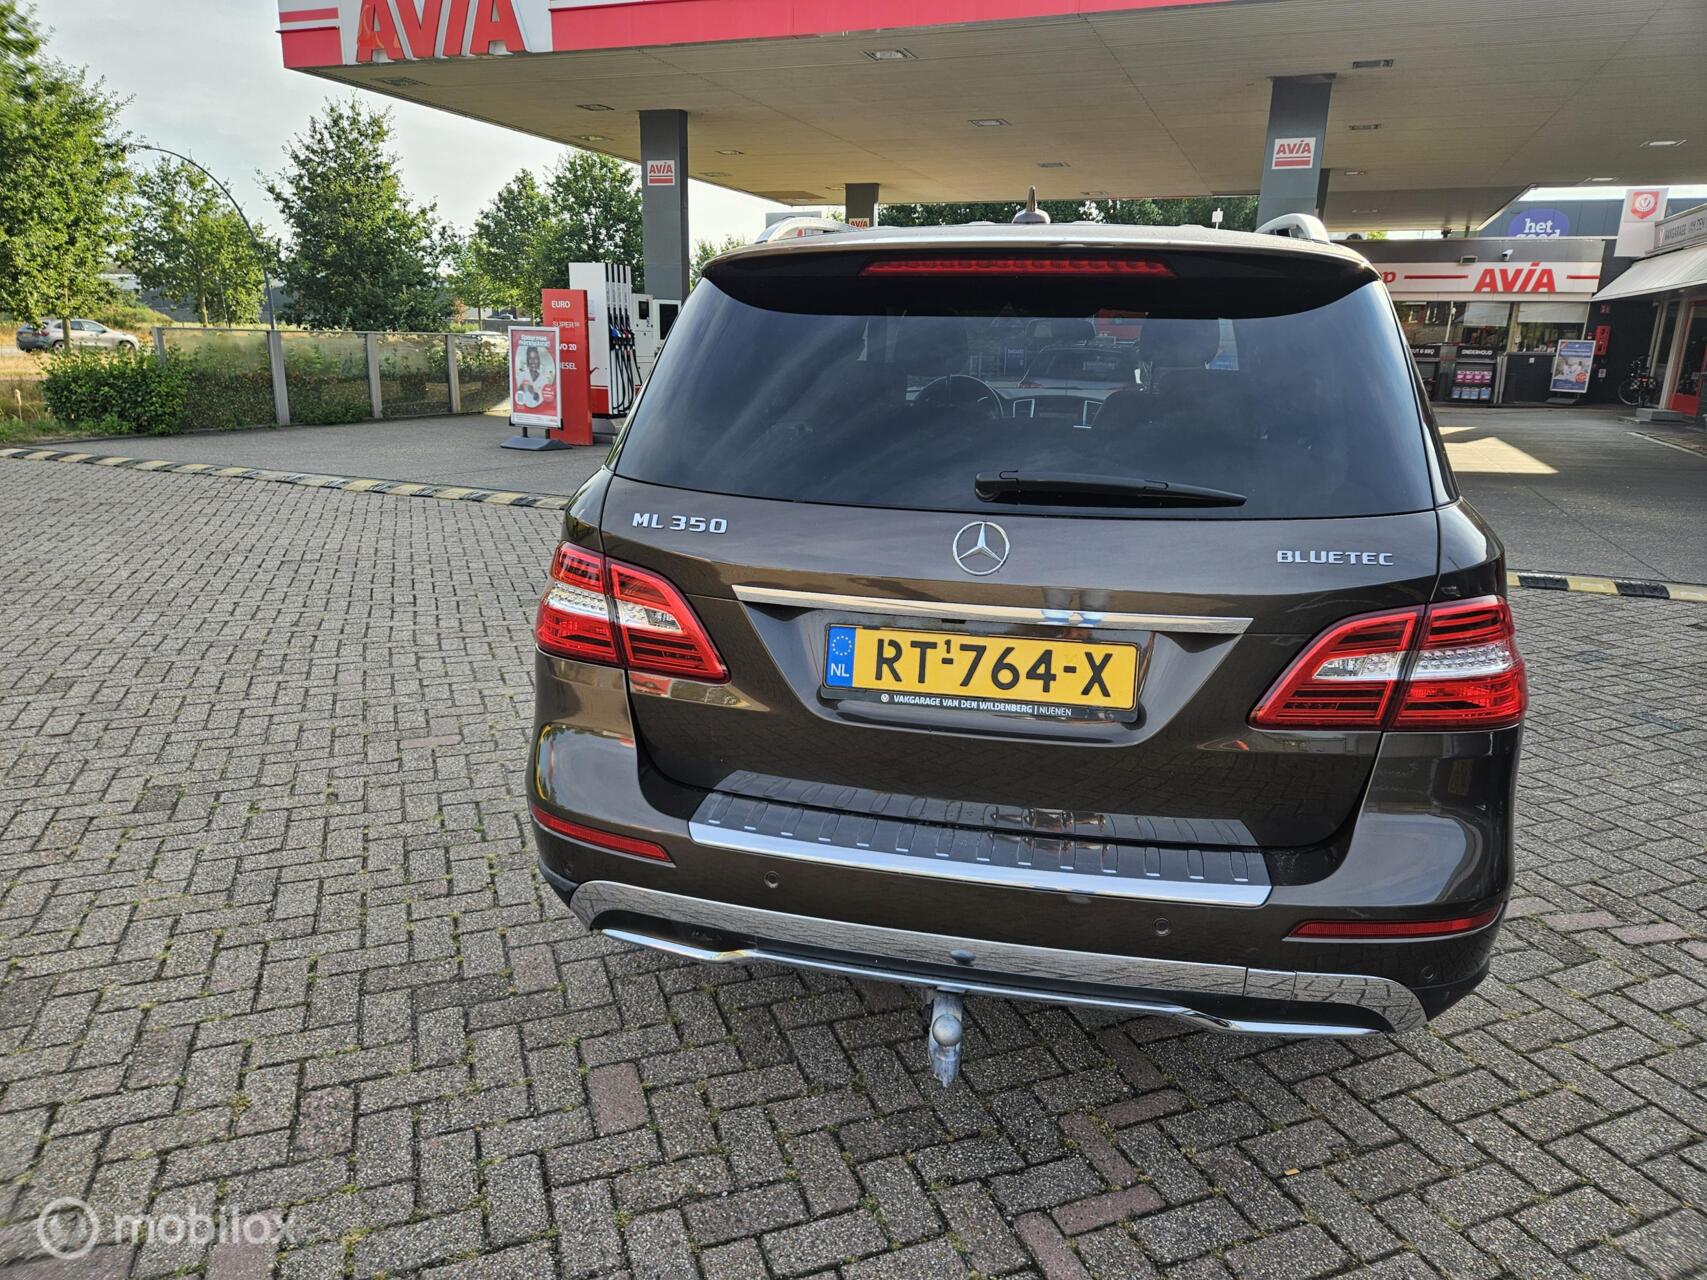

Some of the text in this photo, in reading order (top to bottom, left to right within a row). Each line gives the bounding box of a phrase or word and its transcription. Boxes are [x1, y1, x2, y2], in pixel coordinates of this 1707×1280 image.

[1523, 218, 1553, 233] het
[551, 300, 571, 309] EURO
[632, 512, 728, 534] ML 350
[1276, 550, 1395, 566] BLUETEC
[830, 638, 1113, 698] NL RT-764-X
[894, 694, 1072, 717] VAKGARAGE VAN DEN WILDENBERG NUENEN
